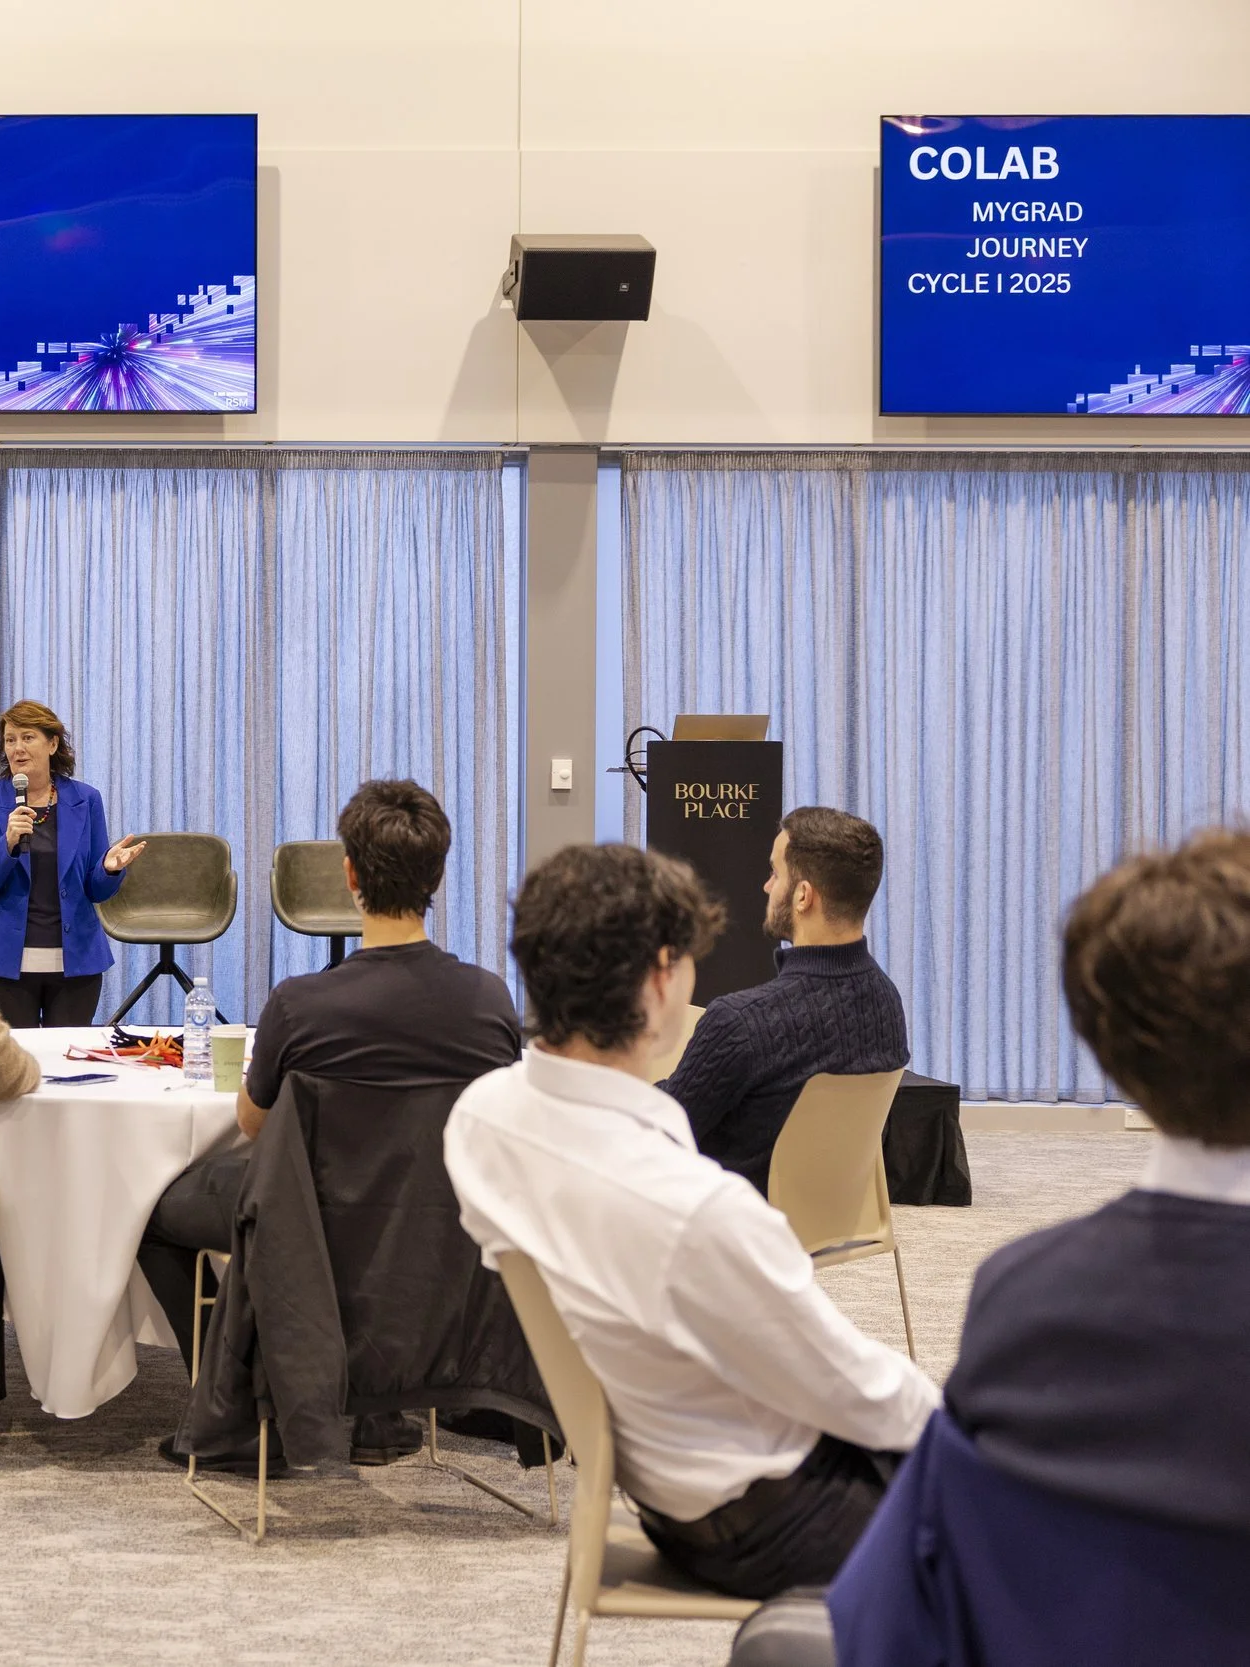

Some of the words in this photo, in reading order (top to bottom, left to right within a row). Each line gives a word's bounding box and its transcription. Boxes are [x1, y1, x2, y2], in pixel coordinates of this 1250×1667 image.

[909, 146, 1060, 181] COLAB
[973, 201, 1083, 222] MYGRAD
[966, 237, 1089, 258] JOURNEY
[908, 273, 990, 294] CYCLE
[1009, 273, 1071, 294] 2025
[225, 397, 249, 407] RSM
[675, 782, 760, 800] BOURKE
[684, 802, 751, 819] PLACE
